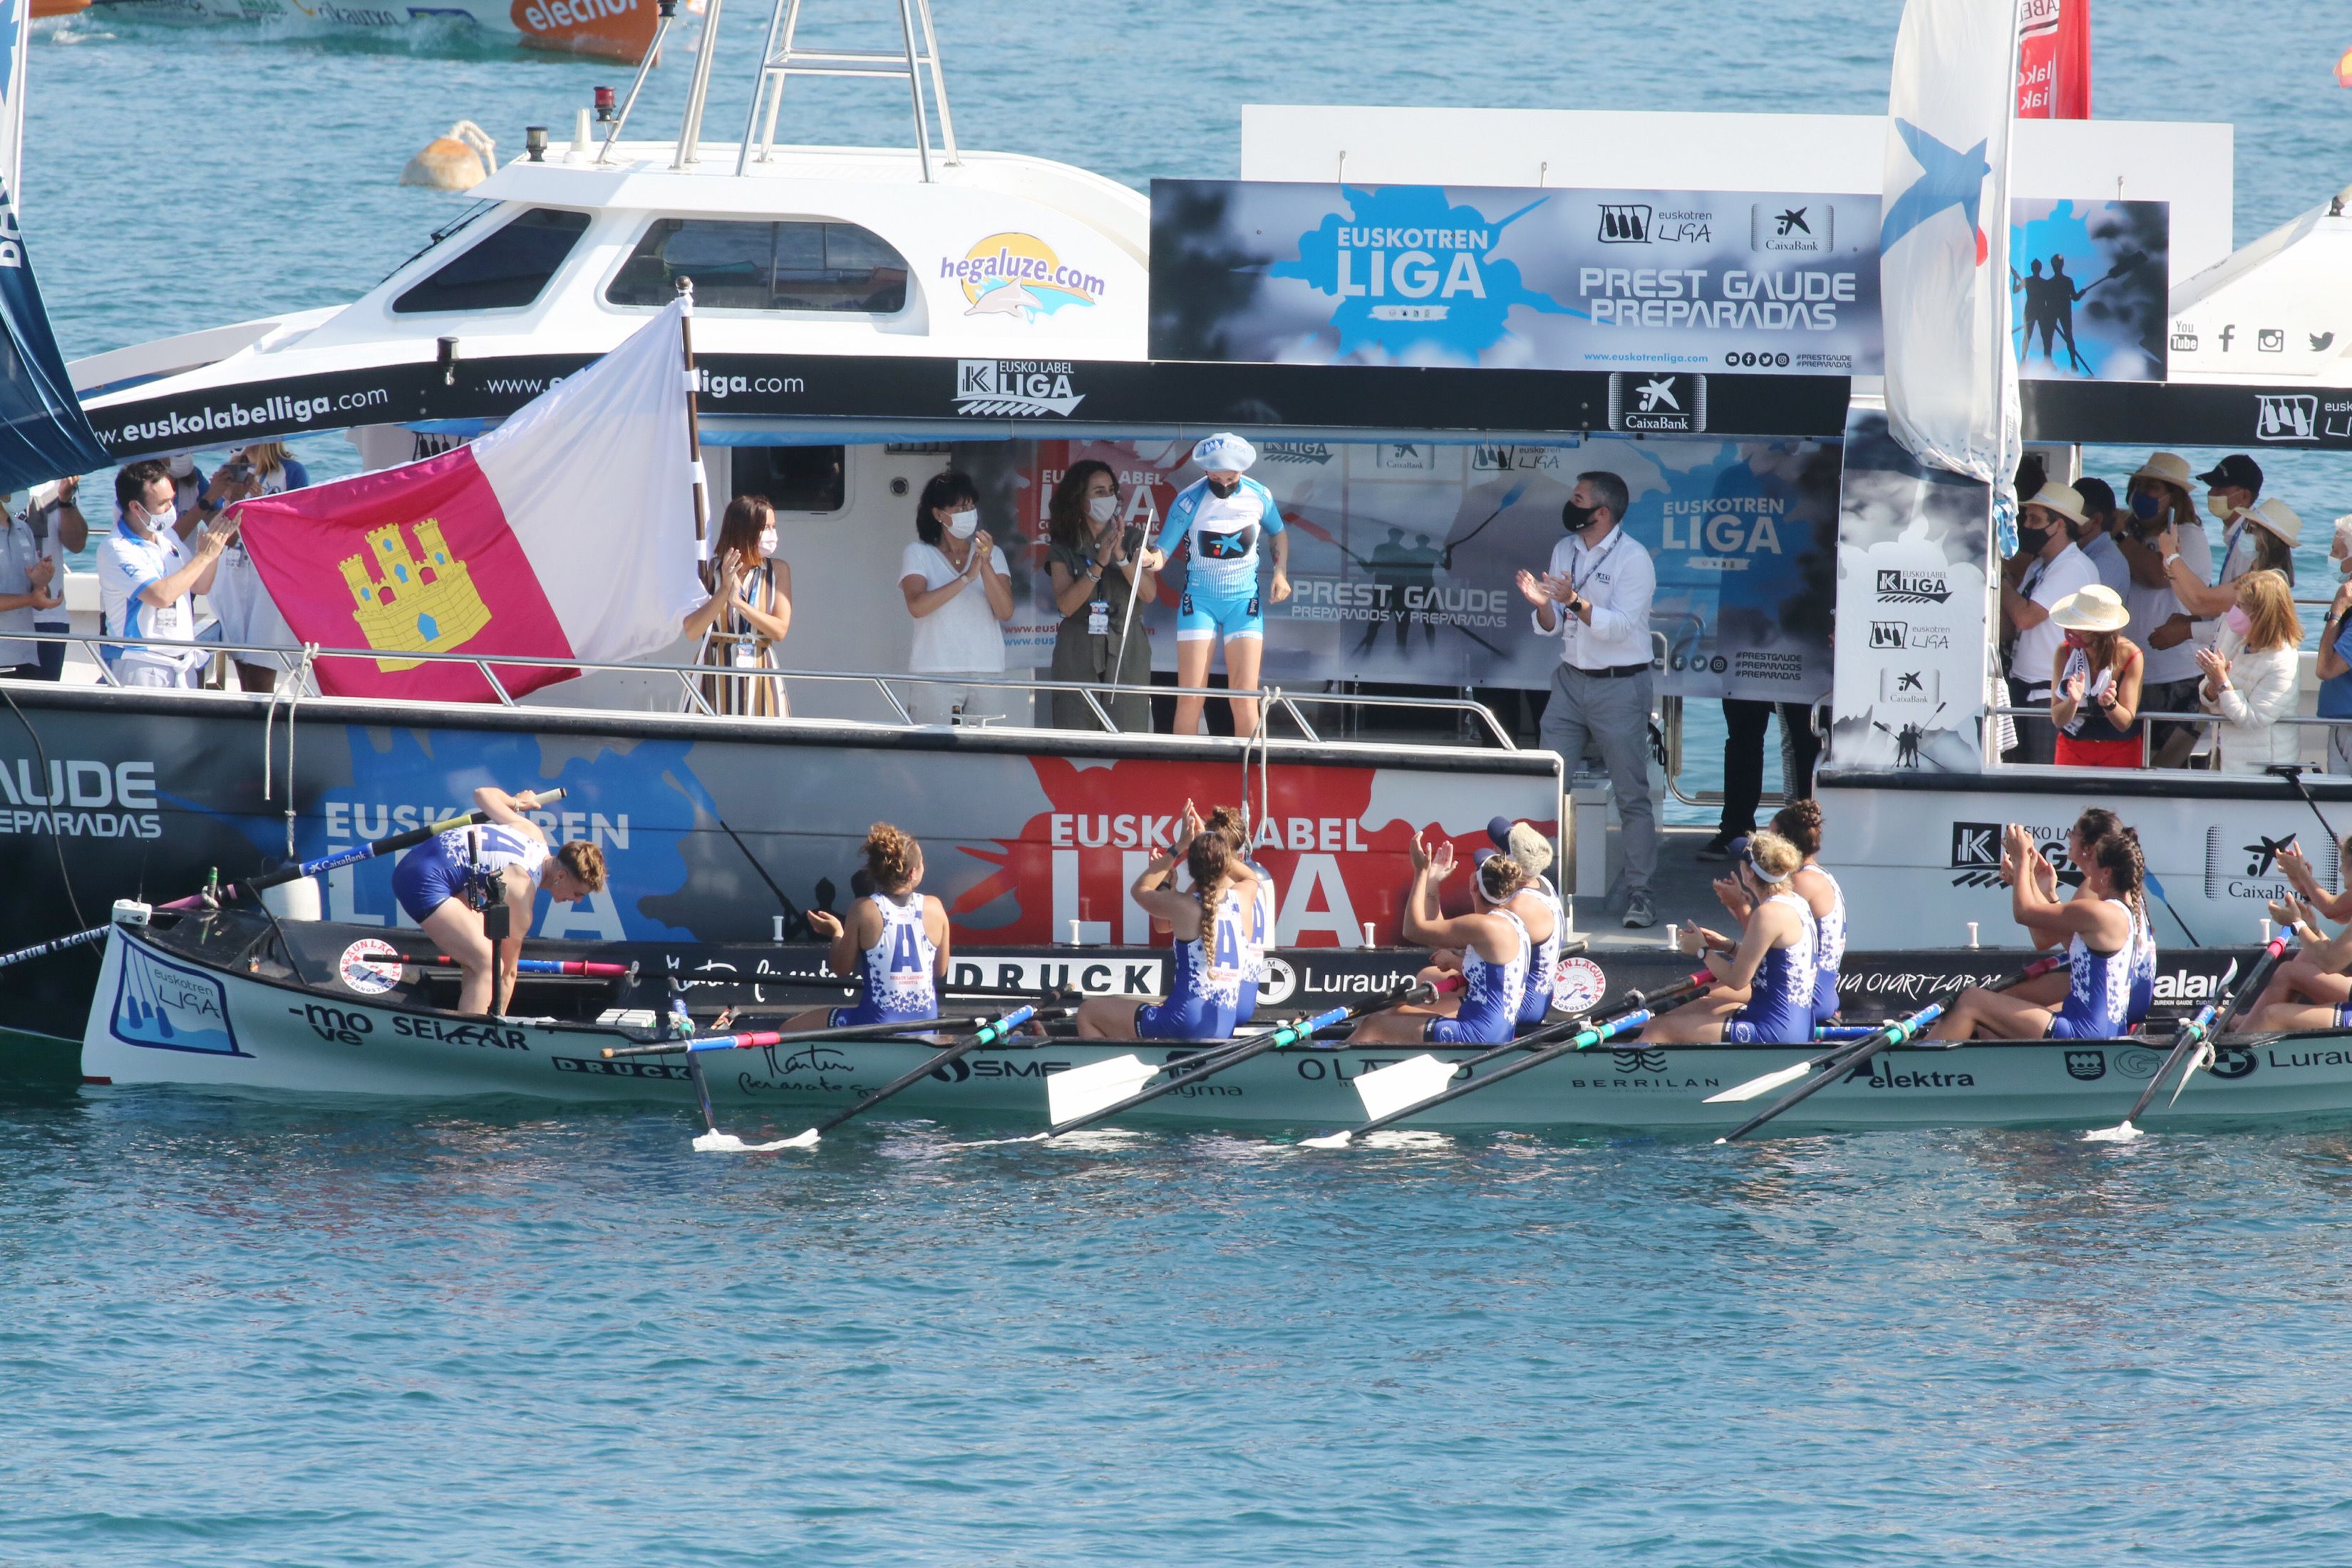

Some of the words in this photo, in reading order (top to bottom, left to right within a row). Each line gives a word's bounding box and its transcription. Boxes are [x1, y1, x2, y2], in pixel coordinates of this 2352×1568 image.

[1659, 210, 1712, 221] euskotren
[1338, 227, 1487, 249] EUSKOTREN
[1659, 223, 1712, 243] LIGA
[1765, 239, 1819, 252] CaixaBank
[939, 247, 1105, 296] hegaluze.com
[1337, 249, 1487, 299] LIGA
[1579, 267, 1708, 298] PREST
[1723, 271, 1856, 301] GAUDE
[1591, 298, 1837, 331] PREPARADAS
[2176, 321, 2194, 333] You
[2172, 336, 2197, 350] Tube
[1584, 352, 1708, 363] www.euskotrenliga.com
[1000, 361, 1036, 373] EUSKO
[1041, 362, 1074, 374] LABEL
[999, 373, 1074, 398] LIGA
[1626, 416, 1688, 430] CaixaBank
[1386, 460, 1424, 469] CaixaBank
[1663, 497, 1784, 516] EUSKOTREN
[1662, 515, 1782, 555] LIGA
[1902, 578, 1947, 592] LIGA
[1293, 580, 1393, 607] PREST
[1404, 586, 1507, 613] GAUDE
[1291, 605, 1390, 622] PREPARADOS
[1395, 610, 1408, 622] Y
[1410, 612, 1507, 628] PREPARADAS
[1912, 625, 1951, 634] euskotren
[1912, 634, 1950, 649] LIGA
[1735, 651, 1802, 662] #PRESTGAUDE
[1735, 661, 1802, 671] #PREPARADOS
[1735, 670, 1802, 681] #PREPARADAS
[1890, 694, 1929, 703] CaixaBank
[321, 851, 366, 870] CaixaBank
[154, 967, 214, 997] euskotren
[955, 963, 1152, 994] DRUCK
[159, 985, 220, 1020] LIGA
[561, 1058, 693, 1080] DRUCK
[1869, 1061, 1974, 1088] elektra
[1572, 1078, 1719, 1088] BERRILAN
